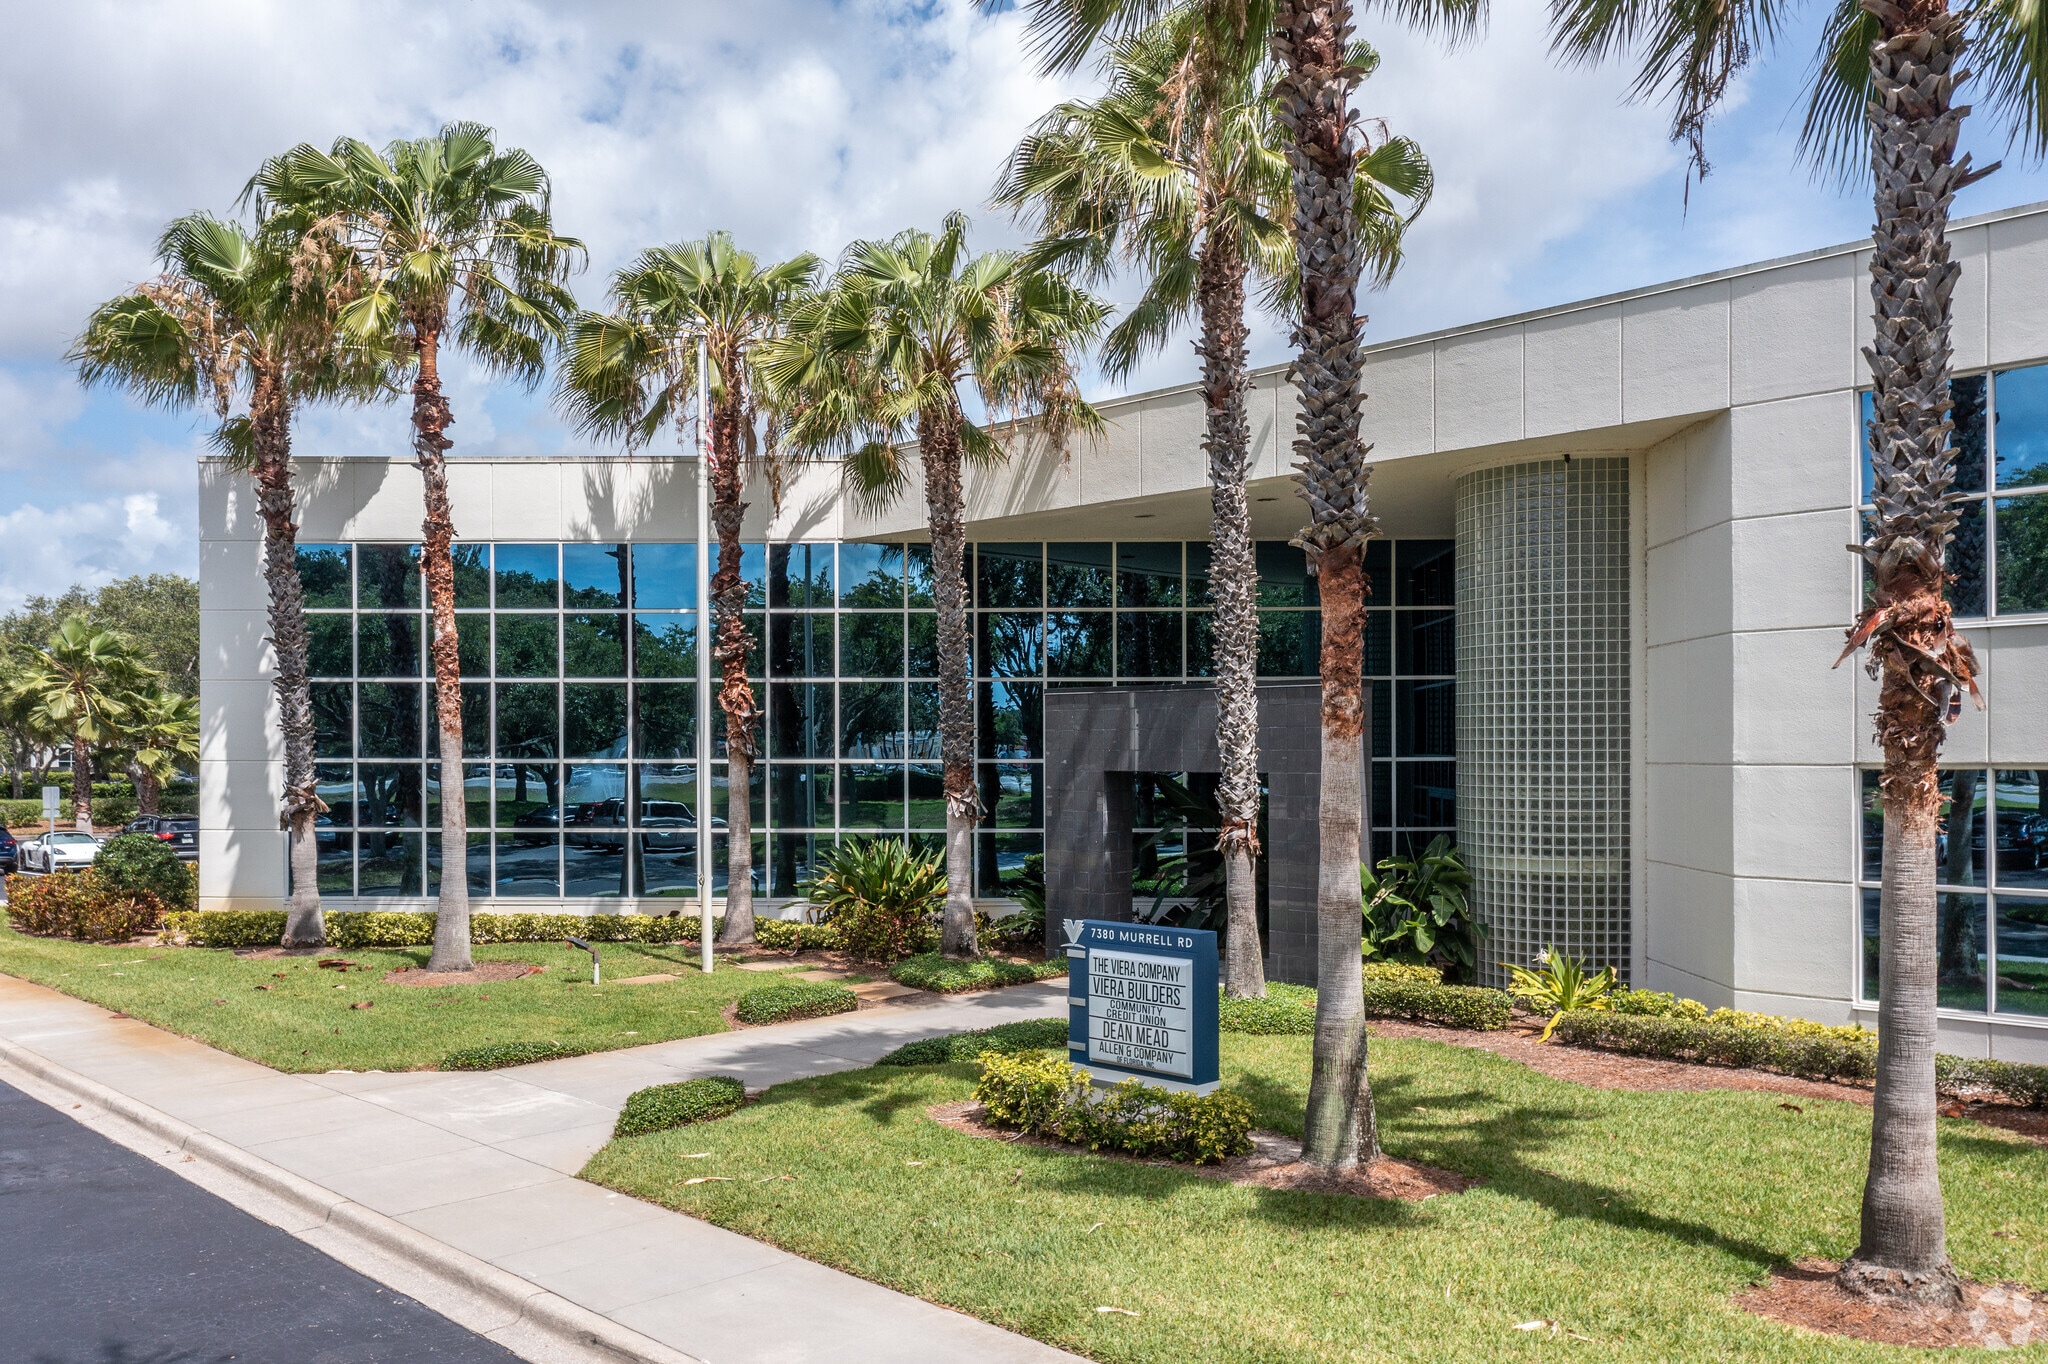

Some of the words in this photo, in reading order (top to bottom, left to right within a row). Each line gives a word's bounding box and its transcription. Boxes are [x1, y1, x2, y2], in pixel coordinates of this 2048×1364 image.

[1091, 928, 1115, 940] 7380
[1119, 931, 1172, 947] MURRELL
[1177, 937, 1193, 949] RD
[1093, 957, 1109, 974] THE
[1110, 960, 1136, 977] VIERA
[1138, 963, 1181, 982] COMPANY
[1093, 977, 1124, 998] VIERA
[1128, 982, 1181, 1006] BUILDERS
[1106, 1008, 1137, 1023] CREDIT
[1139, 1012, 1166, 1027] UNION
[1110, 1000, 1163, 1016] COMMUNITY
[1103, 1021, 1132, 1043] DEAN
[1136, 1026, 1169, 1048] MEAD
[1099, 1041, 1124, 1056] ALLEN
[1126, 1045, 1131, 1057] &
[1134, 1046, 1174, 1064] COMPANY
[1116, 1055, 1123, 1063] OF
